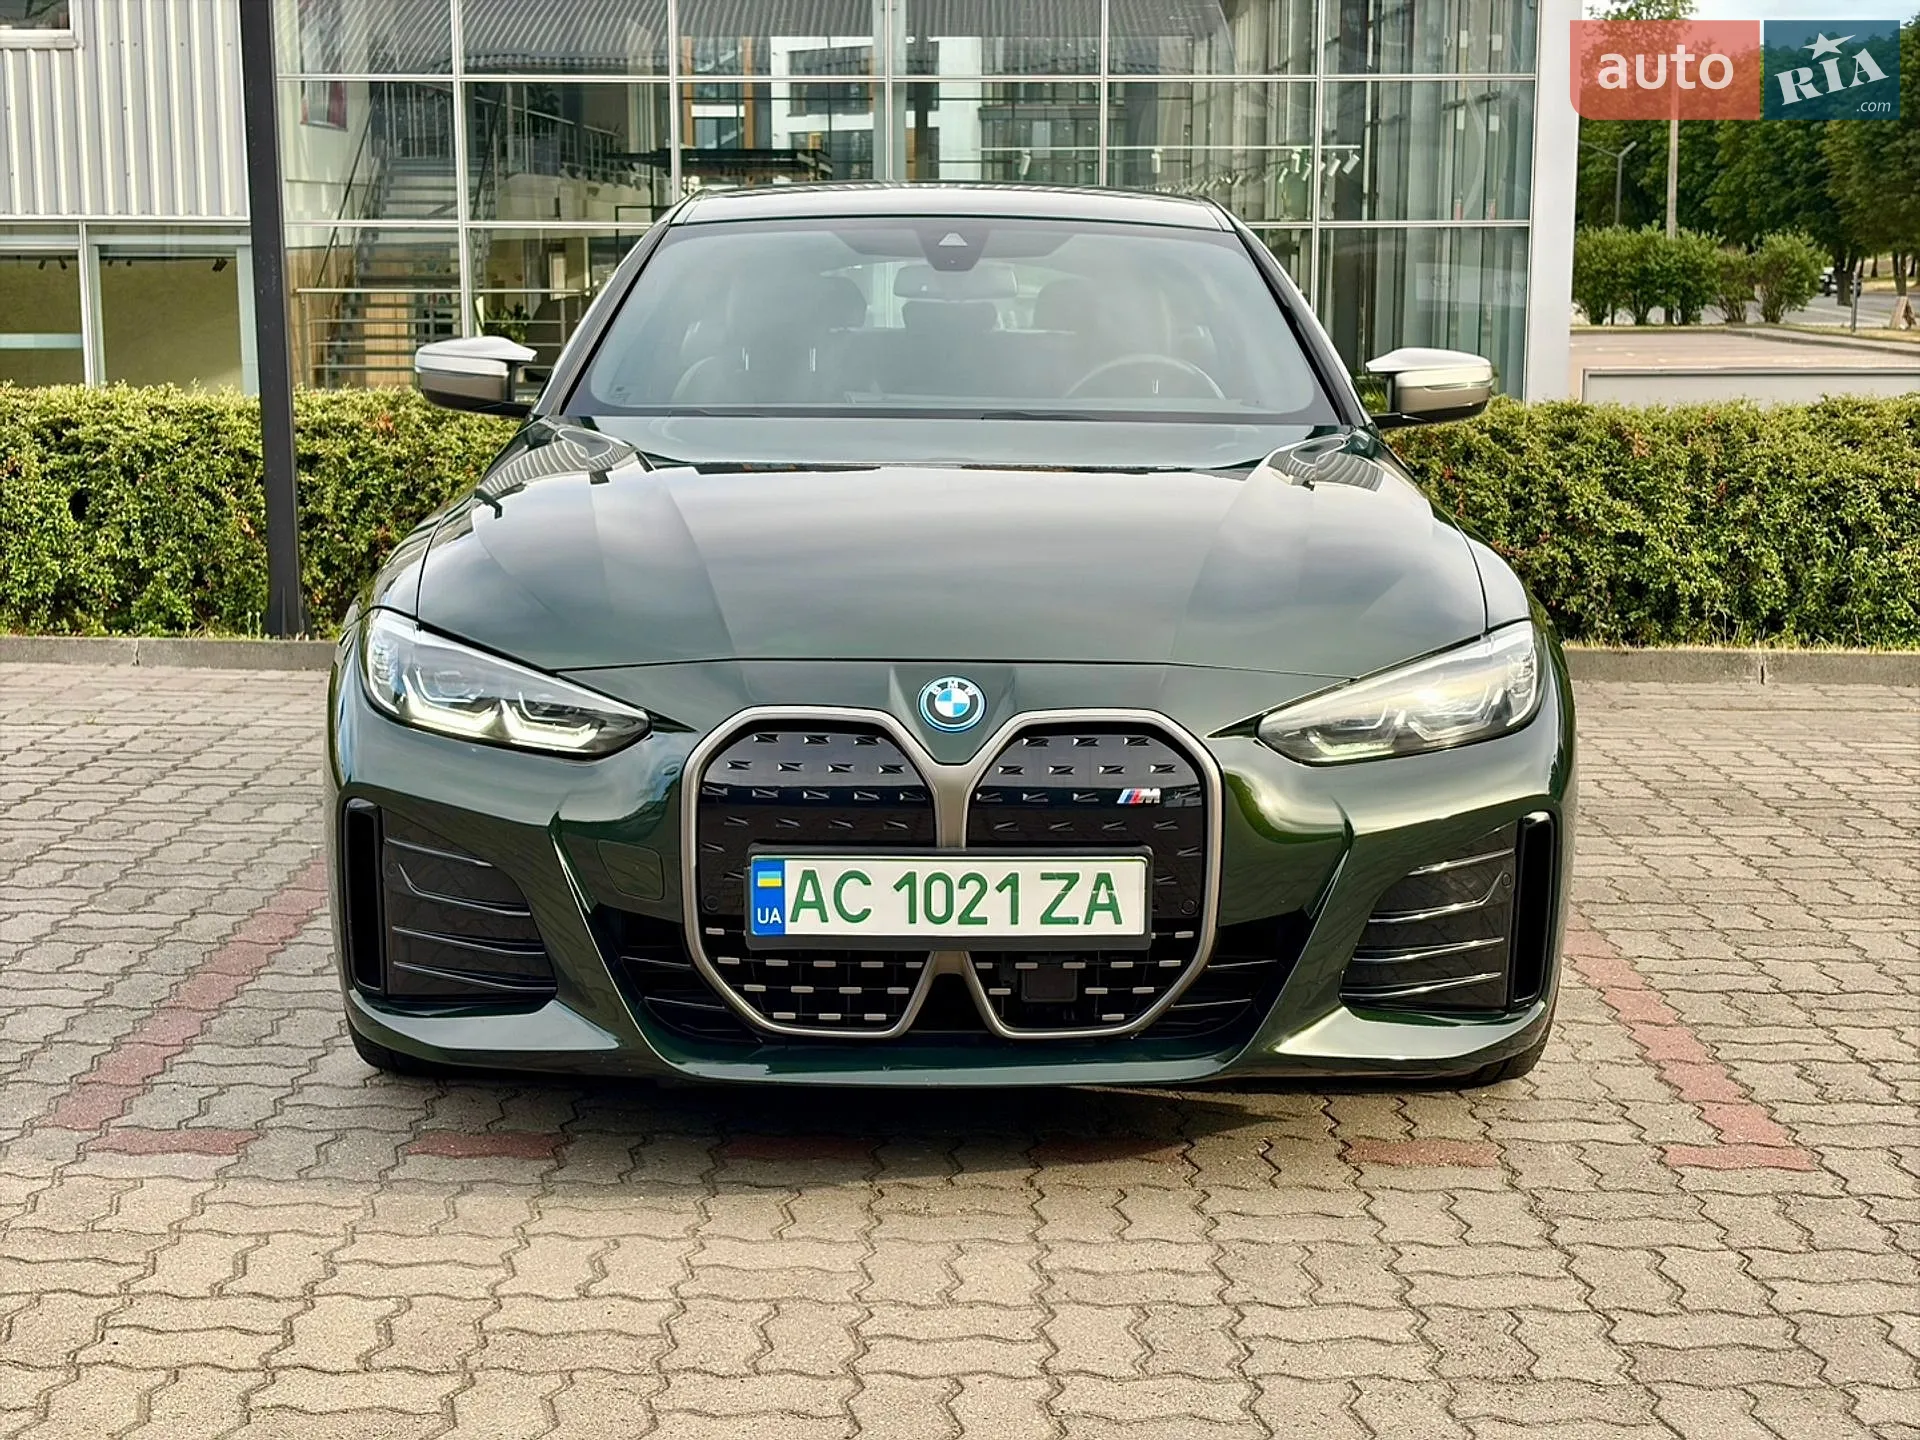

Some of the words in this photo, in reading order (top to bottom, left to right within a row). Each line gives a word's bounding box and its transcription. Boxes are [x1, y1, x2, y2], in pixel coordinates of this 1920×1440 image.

[930, 680, 977, 696] BMW
[789, 869, 872, 924] AC
[892, 871, 1020, 925] 1021
[1039, 872, 1122, 925] ZA
[757, 908, 782, 925] UA
